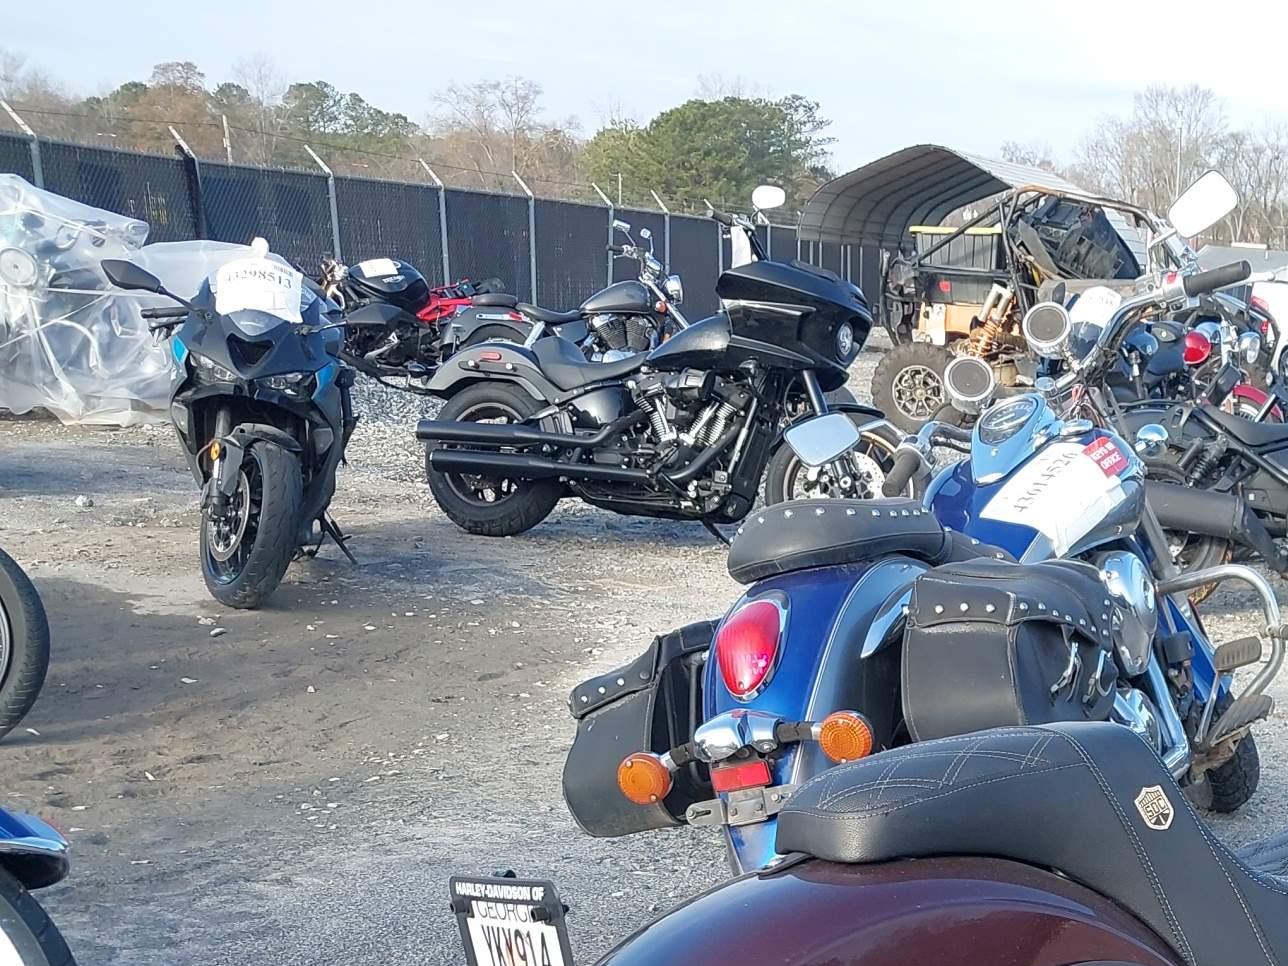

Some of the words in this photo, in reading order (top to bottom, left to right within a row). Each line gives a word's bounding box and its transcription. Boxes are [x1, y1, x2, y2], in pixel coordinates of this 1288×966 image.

[455, 881, 531, 900] HARLEY-DAVIDSON
[531, 886, 545, 901] OF
[476, 900, 540, 923] GEORGI
